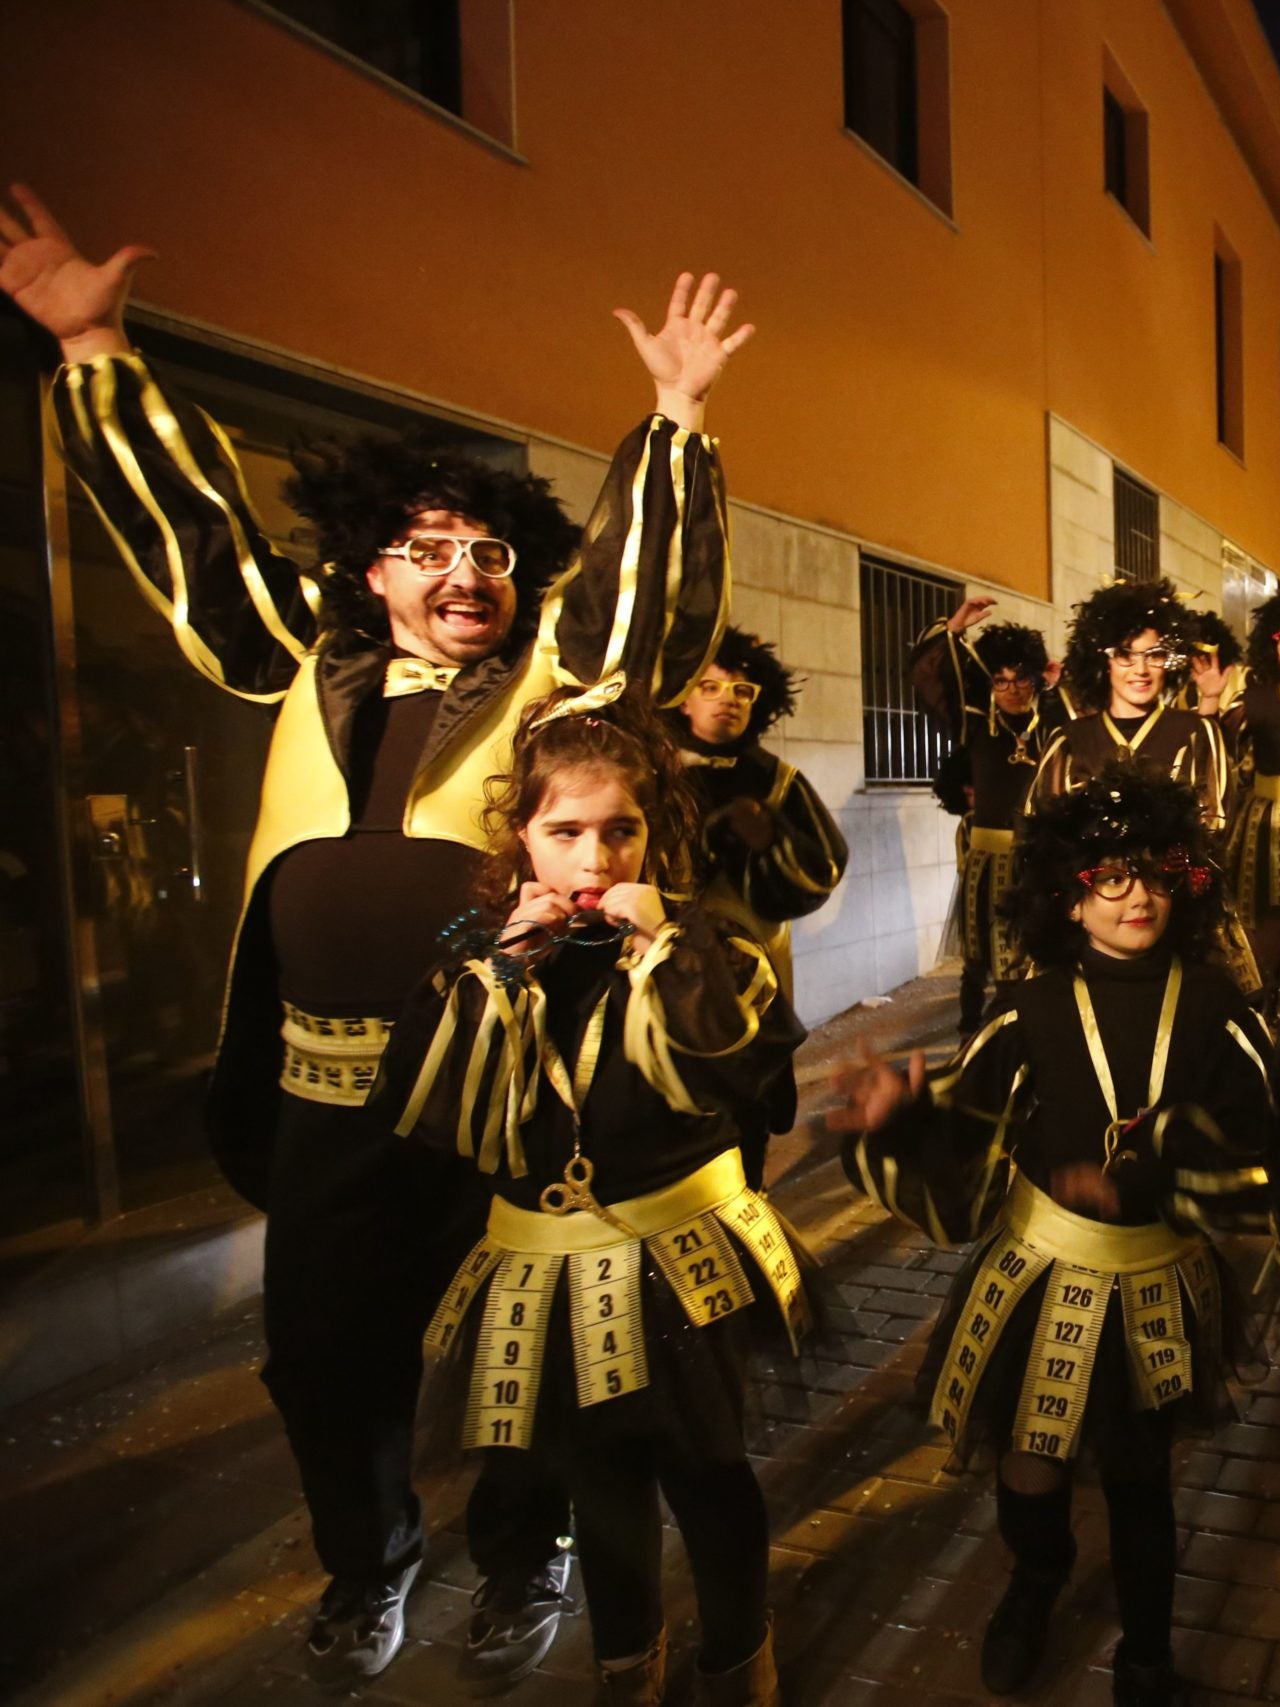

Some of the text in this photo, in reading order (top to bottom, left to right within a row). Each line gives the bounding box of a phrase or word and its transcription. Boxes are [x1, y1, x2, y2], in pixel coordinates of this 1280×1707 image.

[344, 1019, 367, 1036] 13
[673, 1229, 702, 1254] 21
[520, 1264, 533, 1287] 7
[598, 1258, 611, 1280] 2
[688, 1258, 719, 1285] 22
[1000, 1250, 1025, 1278] 80
[599, 1294, 613, 1317] 3
[704, 1290, 733, 1318] 23
[985, 1282, 1004, 1310] 81
[1062, 1285, 1093, 1308] 126
[1139, 1283, 1162, 1305] 117
[511, 1303, 524, 1326] 8
[971, 1313, 990, 1342] 82
[1055, 1321, 1084, 1344] 127
[1141, 1317, 1167, 1339] 118
[504, 1341, 519, 1365] 9
[603, 1331, 616, 1355] 4
[959, 1345, 976, 1375] 83
[1046, 1357, 1075, 1381] 127
[1148, 1347, 1175, 1369] 119
[494, 1380, 519, 1404] 10
[606, 1369, 621, 1394] 5
[949, 1377, 964, 1406] 84
[1155, 1374, 1181, 1399] 120
[1038, 1395, 1068, 1418] 129
[491, 1420, 512, 1443] 11
[1029, 1431, 1059, 1455] 130
